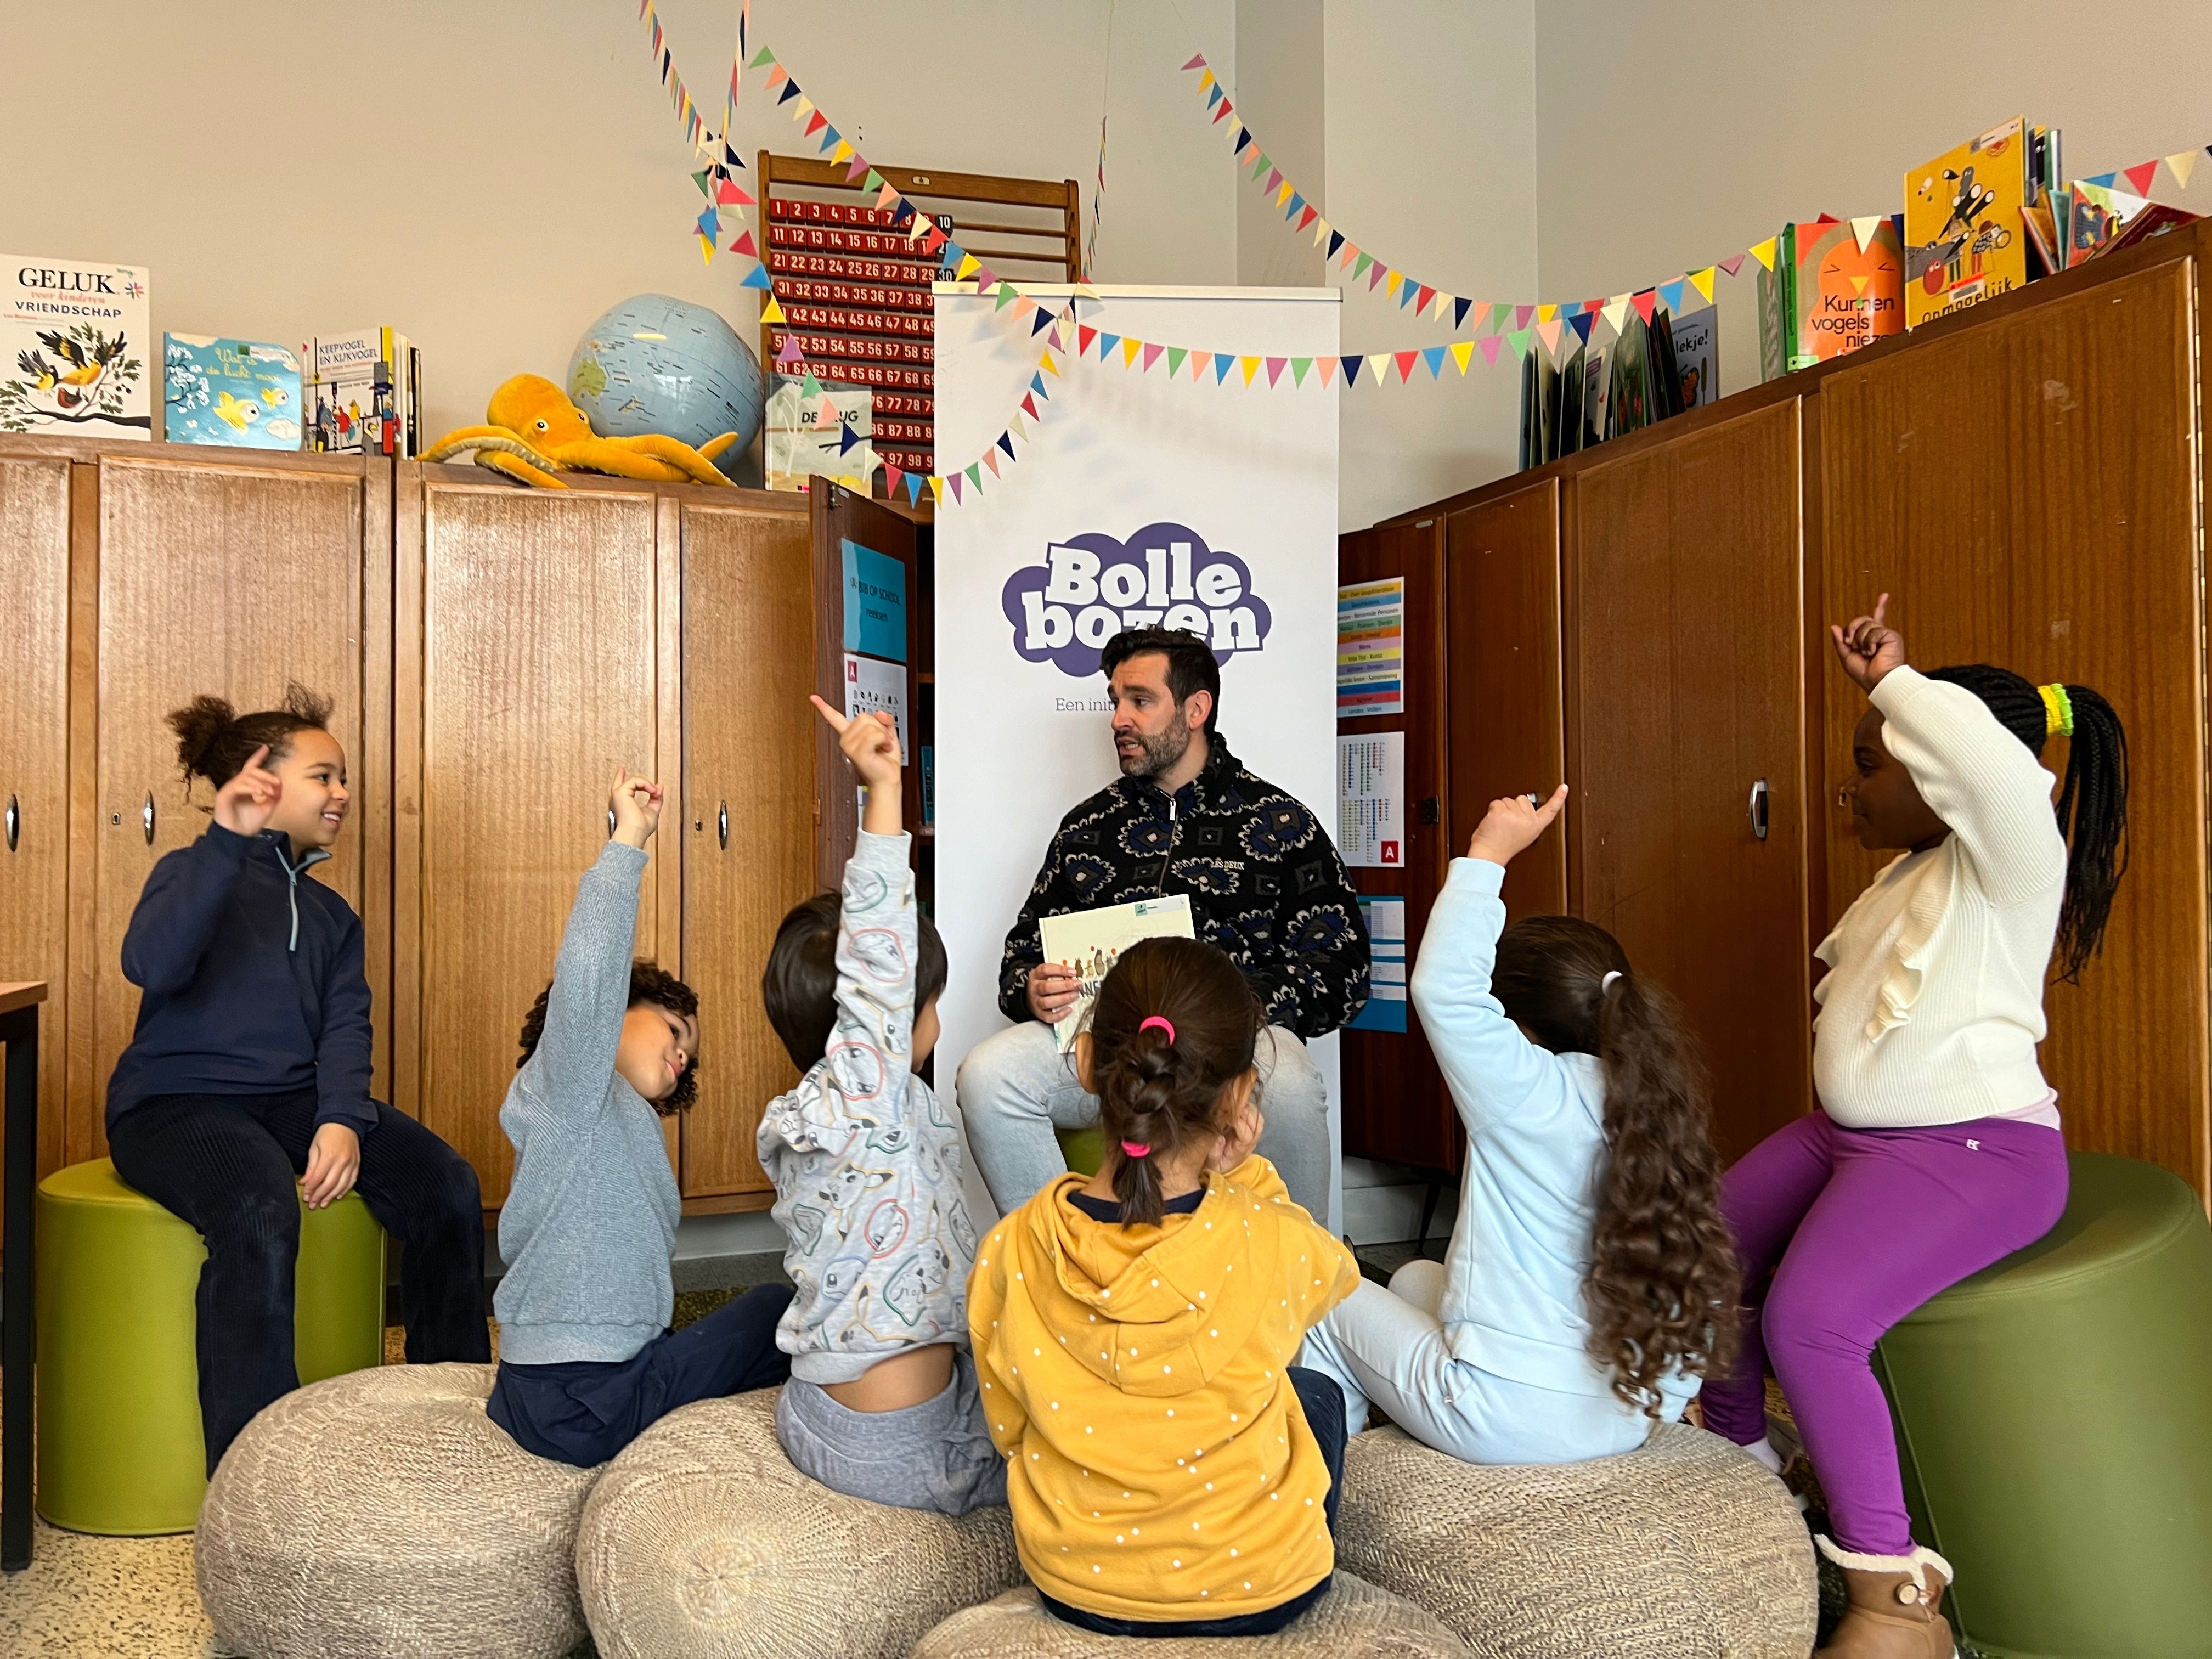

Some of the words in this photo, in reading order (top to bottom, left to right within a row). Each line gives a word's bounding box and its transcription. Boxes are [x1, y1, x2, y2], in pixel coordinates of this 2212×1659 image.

[776, 201, 780, 213] 1
[794, 204, 800, 216] 2
[813, 205, 819, 217] 3
[832, 207, 838, 218] 4
[850, 208, 856, 220] 5
[868, 210, 874, 222] 6
[887, 212, 893, 223] 7
[905, 215, 911, 224] 8
[939, 217, 950, 228] 10
[775, 228, 783, 240] 11
[793, 230, 804, 242] 12
[811, 232, 822, 243] 13
[831, 233, 842, 245] 14
[849, 235, 860, 246] 15
[867, 236, 877, 248] 16
[885, 238, 895, 249] 17
[904, 239, 914, 251] 18
[922, 240, 926, 252] 1
[774, 255, 785, 267] 21
[792, 257, 805, 268] 22
[811, 258, 823, 270] 23
[830, 260, 843, 272] 24
[848, 262, 862, 274] 25
[866, 264, 879, 275] 26
[884, 265, 898, 277] 27
[903, 267, 916, 279] 28
[922, 268, 934, 280] 29
[939, 270, 952, 281] 30
[18, 268, 115, 294] GELUK
[31, 291, 54, 300] voor
[58, 291, 105, 304] kinderen
[778, 282, 789, 294] 31
[796, 284, 810, 296] 32
[815, 285, 828, 297] 33
[834, 287, 848, 299] 34
[853, 289, 867, 300] 35
[871, 290, 884, 302] 36
[889, 291, 903, 303] 37
[908, 293, 921, 305] 38
[927, 294, 934, 306] 3
[15, 301, 121, 318] VRIENDSCHAP
[1825, 295, 1894, 312] Kunnen
[782, 307, 786, 318] 1
[793, 309, 807, 321] 42
[812, 311, 826, 323] 43
[831, 312, 845, 324] 44
[849, 314, 864, 326] 45
[867, 315, 881, 328] 46
[886, 317, 900, 329] 47
[905, 318, 918, 330] 48
[1812, 313, 1870, 334] vogels
[319, 340, 365, 354] KEEPVOGEL
[775, 336, 786, 348] 51
[812, 338, 826, 351] 53
[831, 340, 844, 352] 54
[850, 341, 864, 353] 55
[867, 343, 881, 355] 56
[886, 344, 899, 356] 57
[905, 346, 918, 358] 58
[1676, 329, 1708, 354] lekje!
[1846, 331, 1889, 347] niez
[776, 362, 787, 373] 61
[794, 363, 808, 374] 62
[812, 364, 826, 376] 63
[832, 366, 845, 377] 64
[850, 368, 865, 379] 65
[868, 369, 882, 381] 66
[887, 370, 900, 382] 67
[905, 372, 918, 383] 68
[888, 398, 901, 409] 77
[906, 399, 920, 410] 78
[802, 412, 818, 423] DE
[834, 410, 859, 422] UG
[889, 425, 902, 437] 87
[907, 426, 921, 438] 88
[926, 427, 934, 439] 8
[889, 453, 902, 465] 97
[908, 454, 921, 466] 98
[927, 456, 933, 467] 9
[1045, 542, 1242, 607] Bolle
[1021, 591, 1260, 650] bozen
[849, 665, 855, 678] A
[1056, 698, 1085, 711] Een
[1088, 698, 1115, 711] init
[1385, 845, 1394, 859] A
[1224, 861, 1245, 870] DEUX
